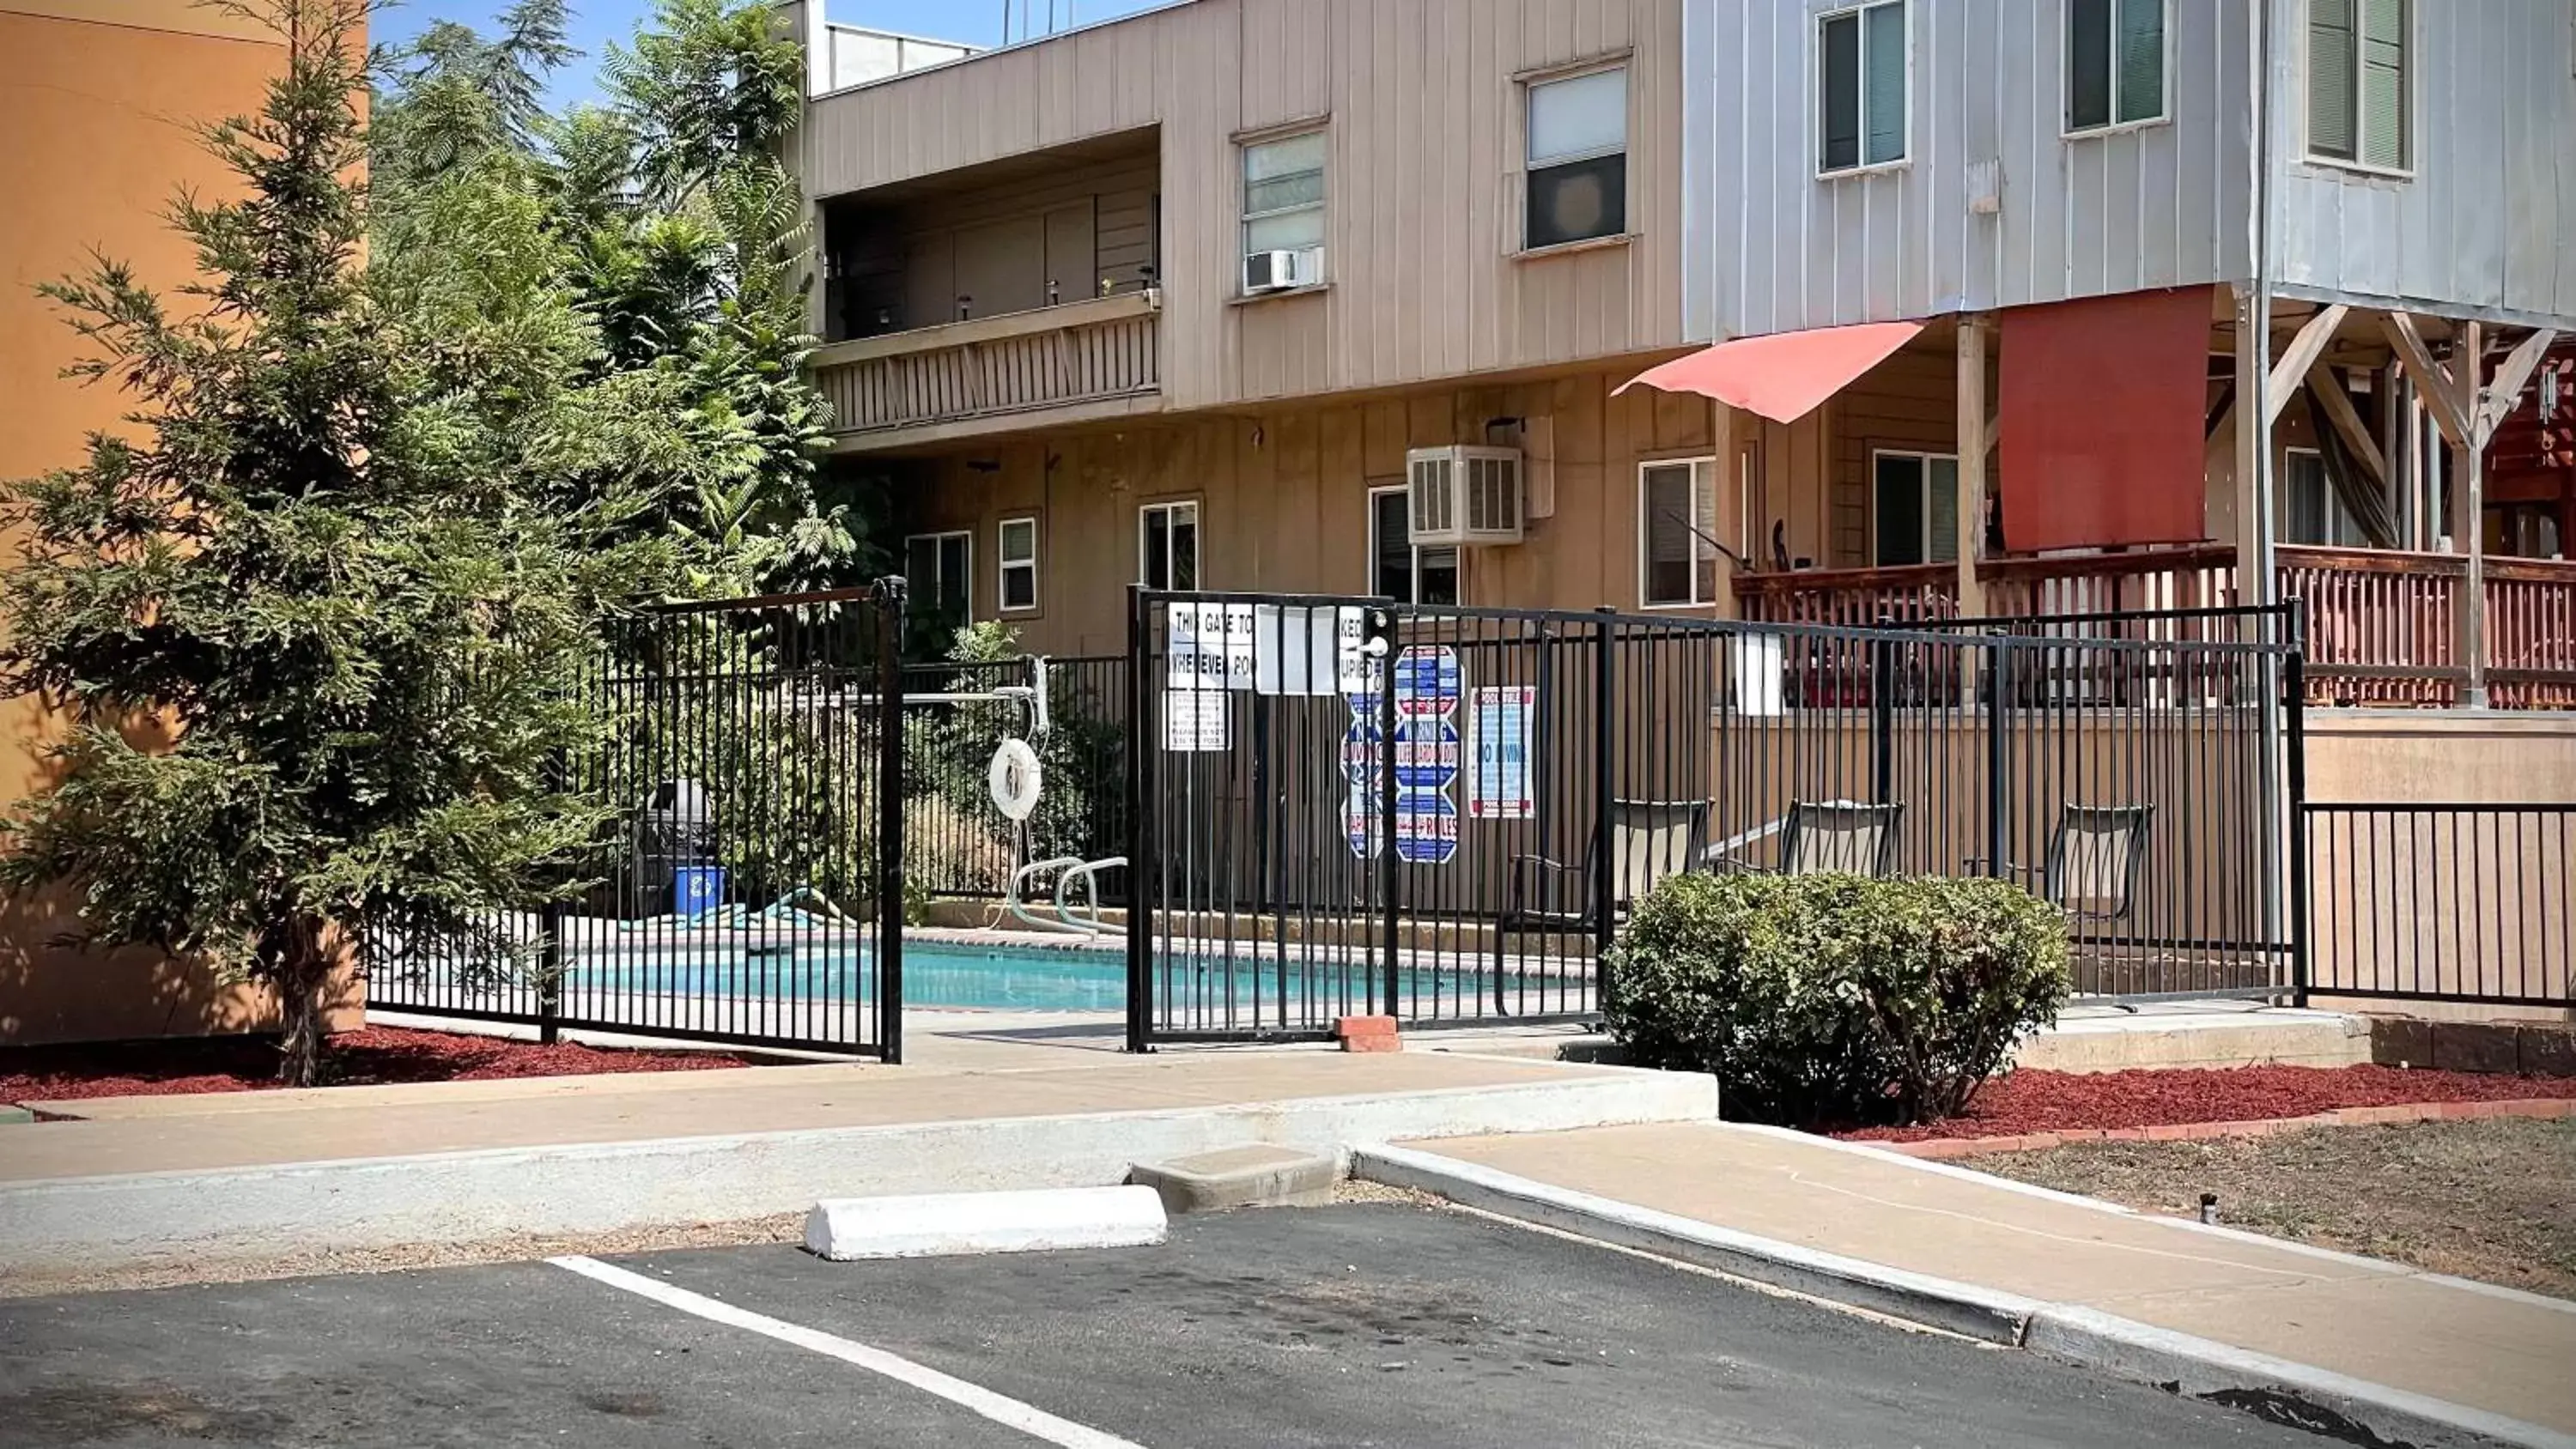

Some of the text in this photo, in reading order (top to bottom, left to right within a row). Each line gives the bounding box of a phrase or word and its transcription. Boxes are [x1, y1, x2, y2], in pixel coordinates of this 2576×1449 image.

[1176, 611, 1200, 633] THI
[1171, 652, 1257, 676] WHEEVE PO
[1404, 721, 1448, 741] WRNIG
